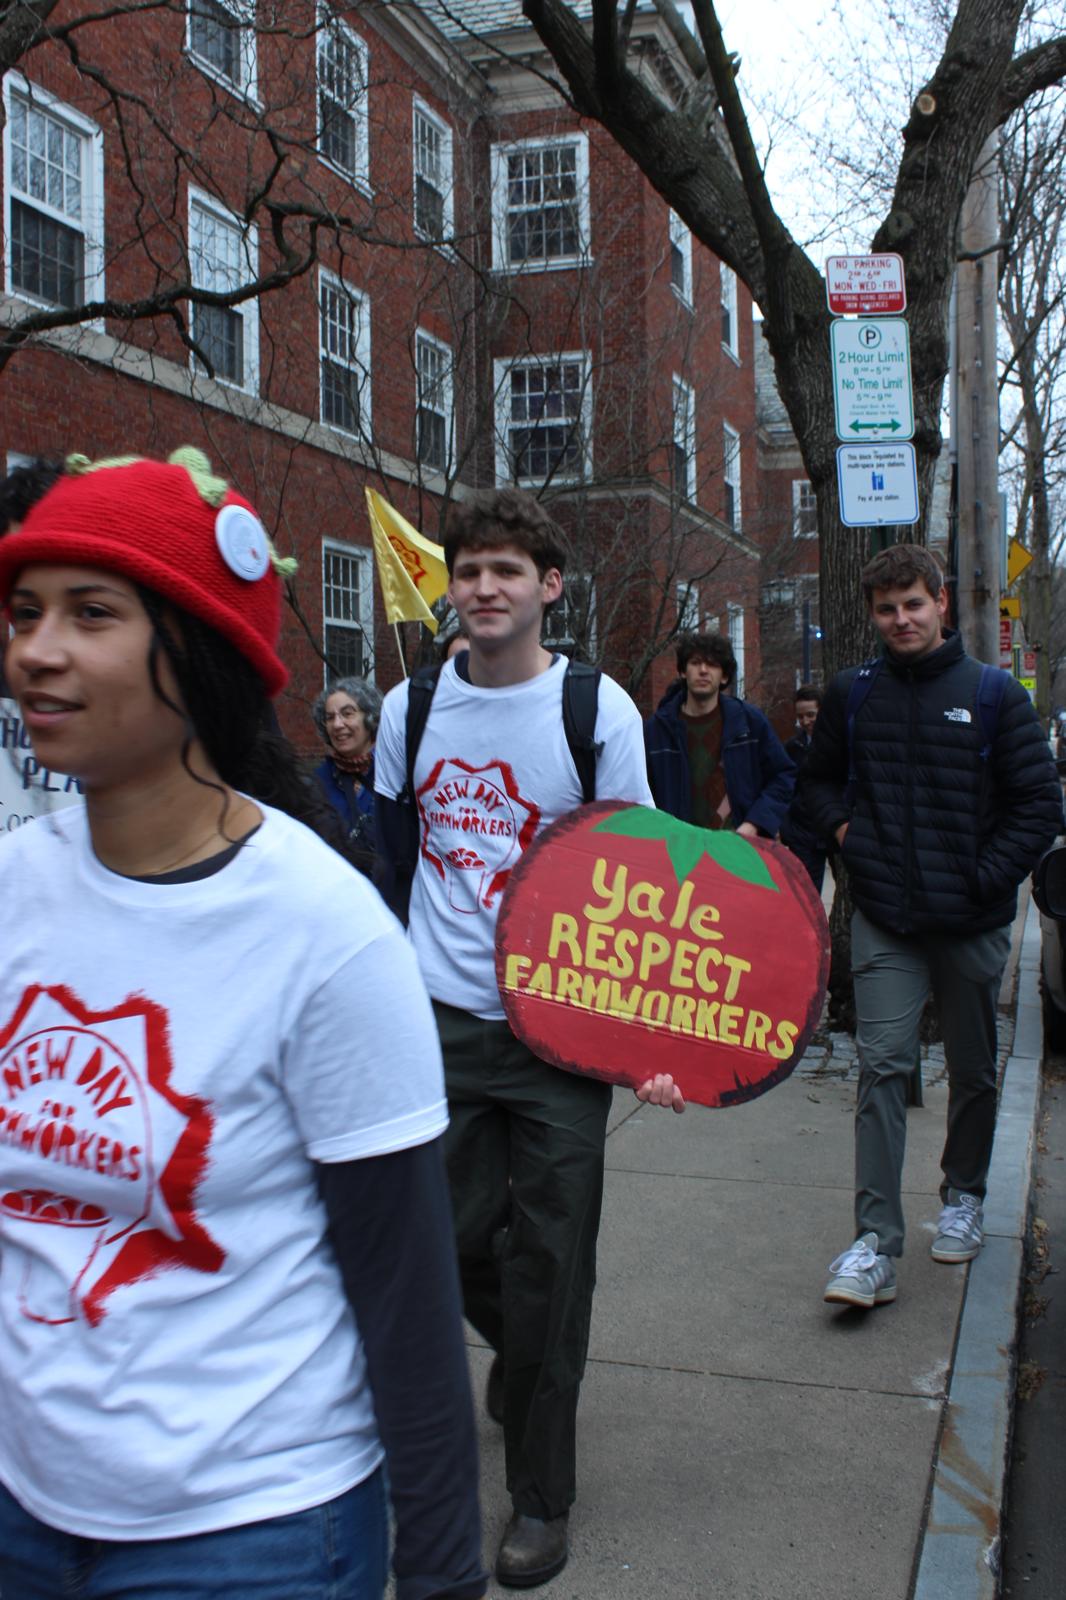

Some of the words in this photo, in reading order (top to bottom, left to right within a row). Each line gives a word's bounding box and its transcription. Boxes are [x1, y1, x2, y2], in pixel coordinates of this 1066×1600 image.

[836, 259, 848, 269] NO
[854, 258, 892, 269] PARKING
[834, 281, 853, 291] MON
[858, 281, 877, 291] WED
[883, 280, 897, 290] FRI
[865, 328, 877, 345] P
[839, 351, 846, 364] 2
[847, 351, 874, 363] Hour
[878, 350, 904, 363] Limit
[842, 378, 855, 390] No
[858, 377, 880, 390] Time
[882, 377, 903, 390] Limit
[434, 779, 469, 809] NEW
[474, 783, 505, 813] DAY
[430, 811, 512, 837] FARMWORKERS
[548, 912, 752, 1002] RESPECT
[504, 953, 799, 1060] FARMWORKERS
[3, 1036, 76, 1099] NEW
[75, 1046, 134, 1118] DAY
